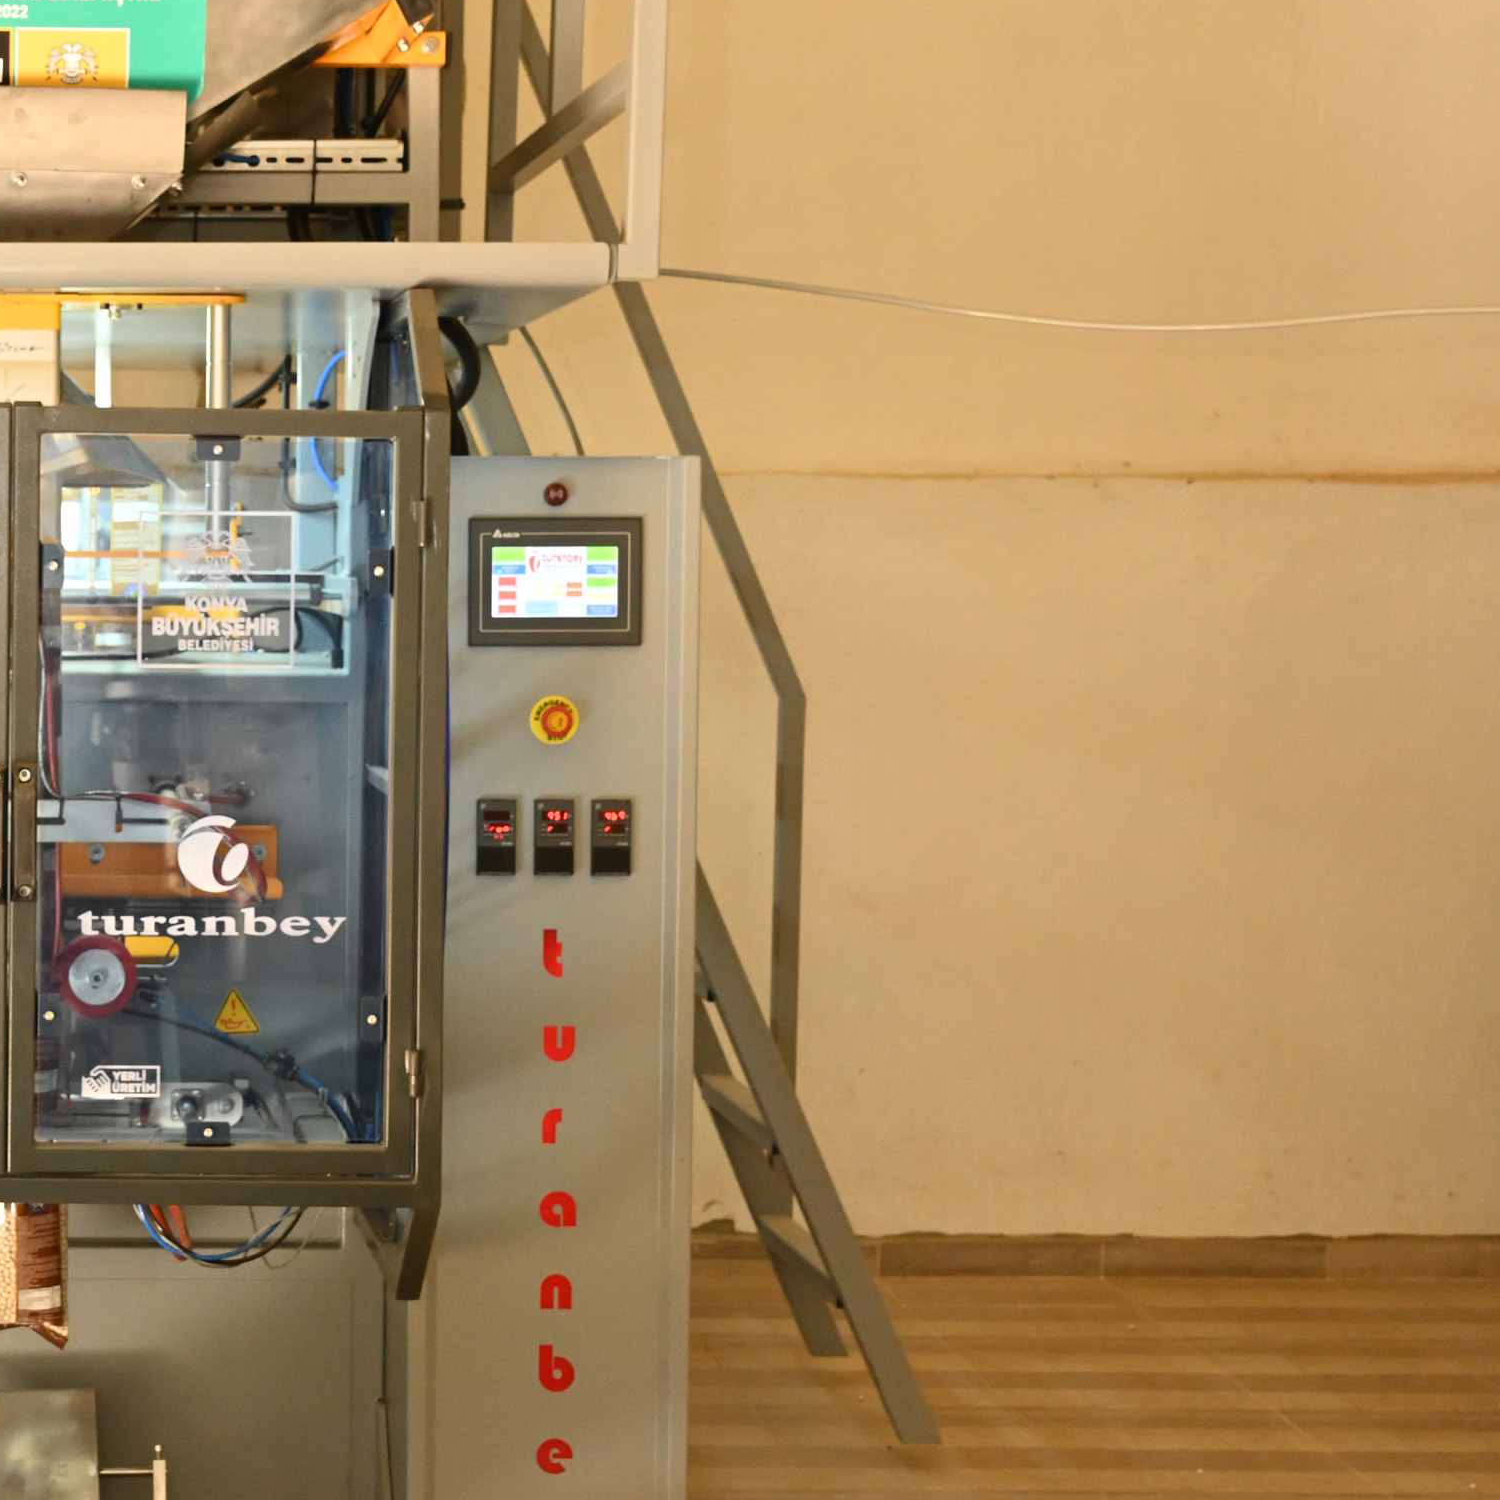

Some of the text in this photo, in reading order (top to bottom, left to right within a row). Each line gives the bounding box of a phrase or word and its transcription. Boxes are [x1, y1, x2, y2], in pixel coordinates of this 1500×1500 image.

[185, 596, 248, 613] KONYA
[152, 613, 279, 640] BÜYÜKŞEHİR
[178, 637, 253, 651] BELEDİYESİ
[77, 906, 347, 943] turanbey
[112, 1068, 147, 1082] YERLİ
[112, 1080, 156, 1093] ÜRETİM
